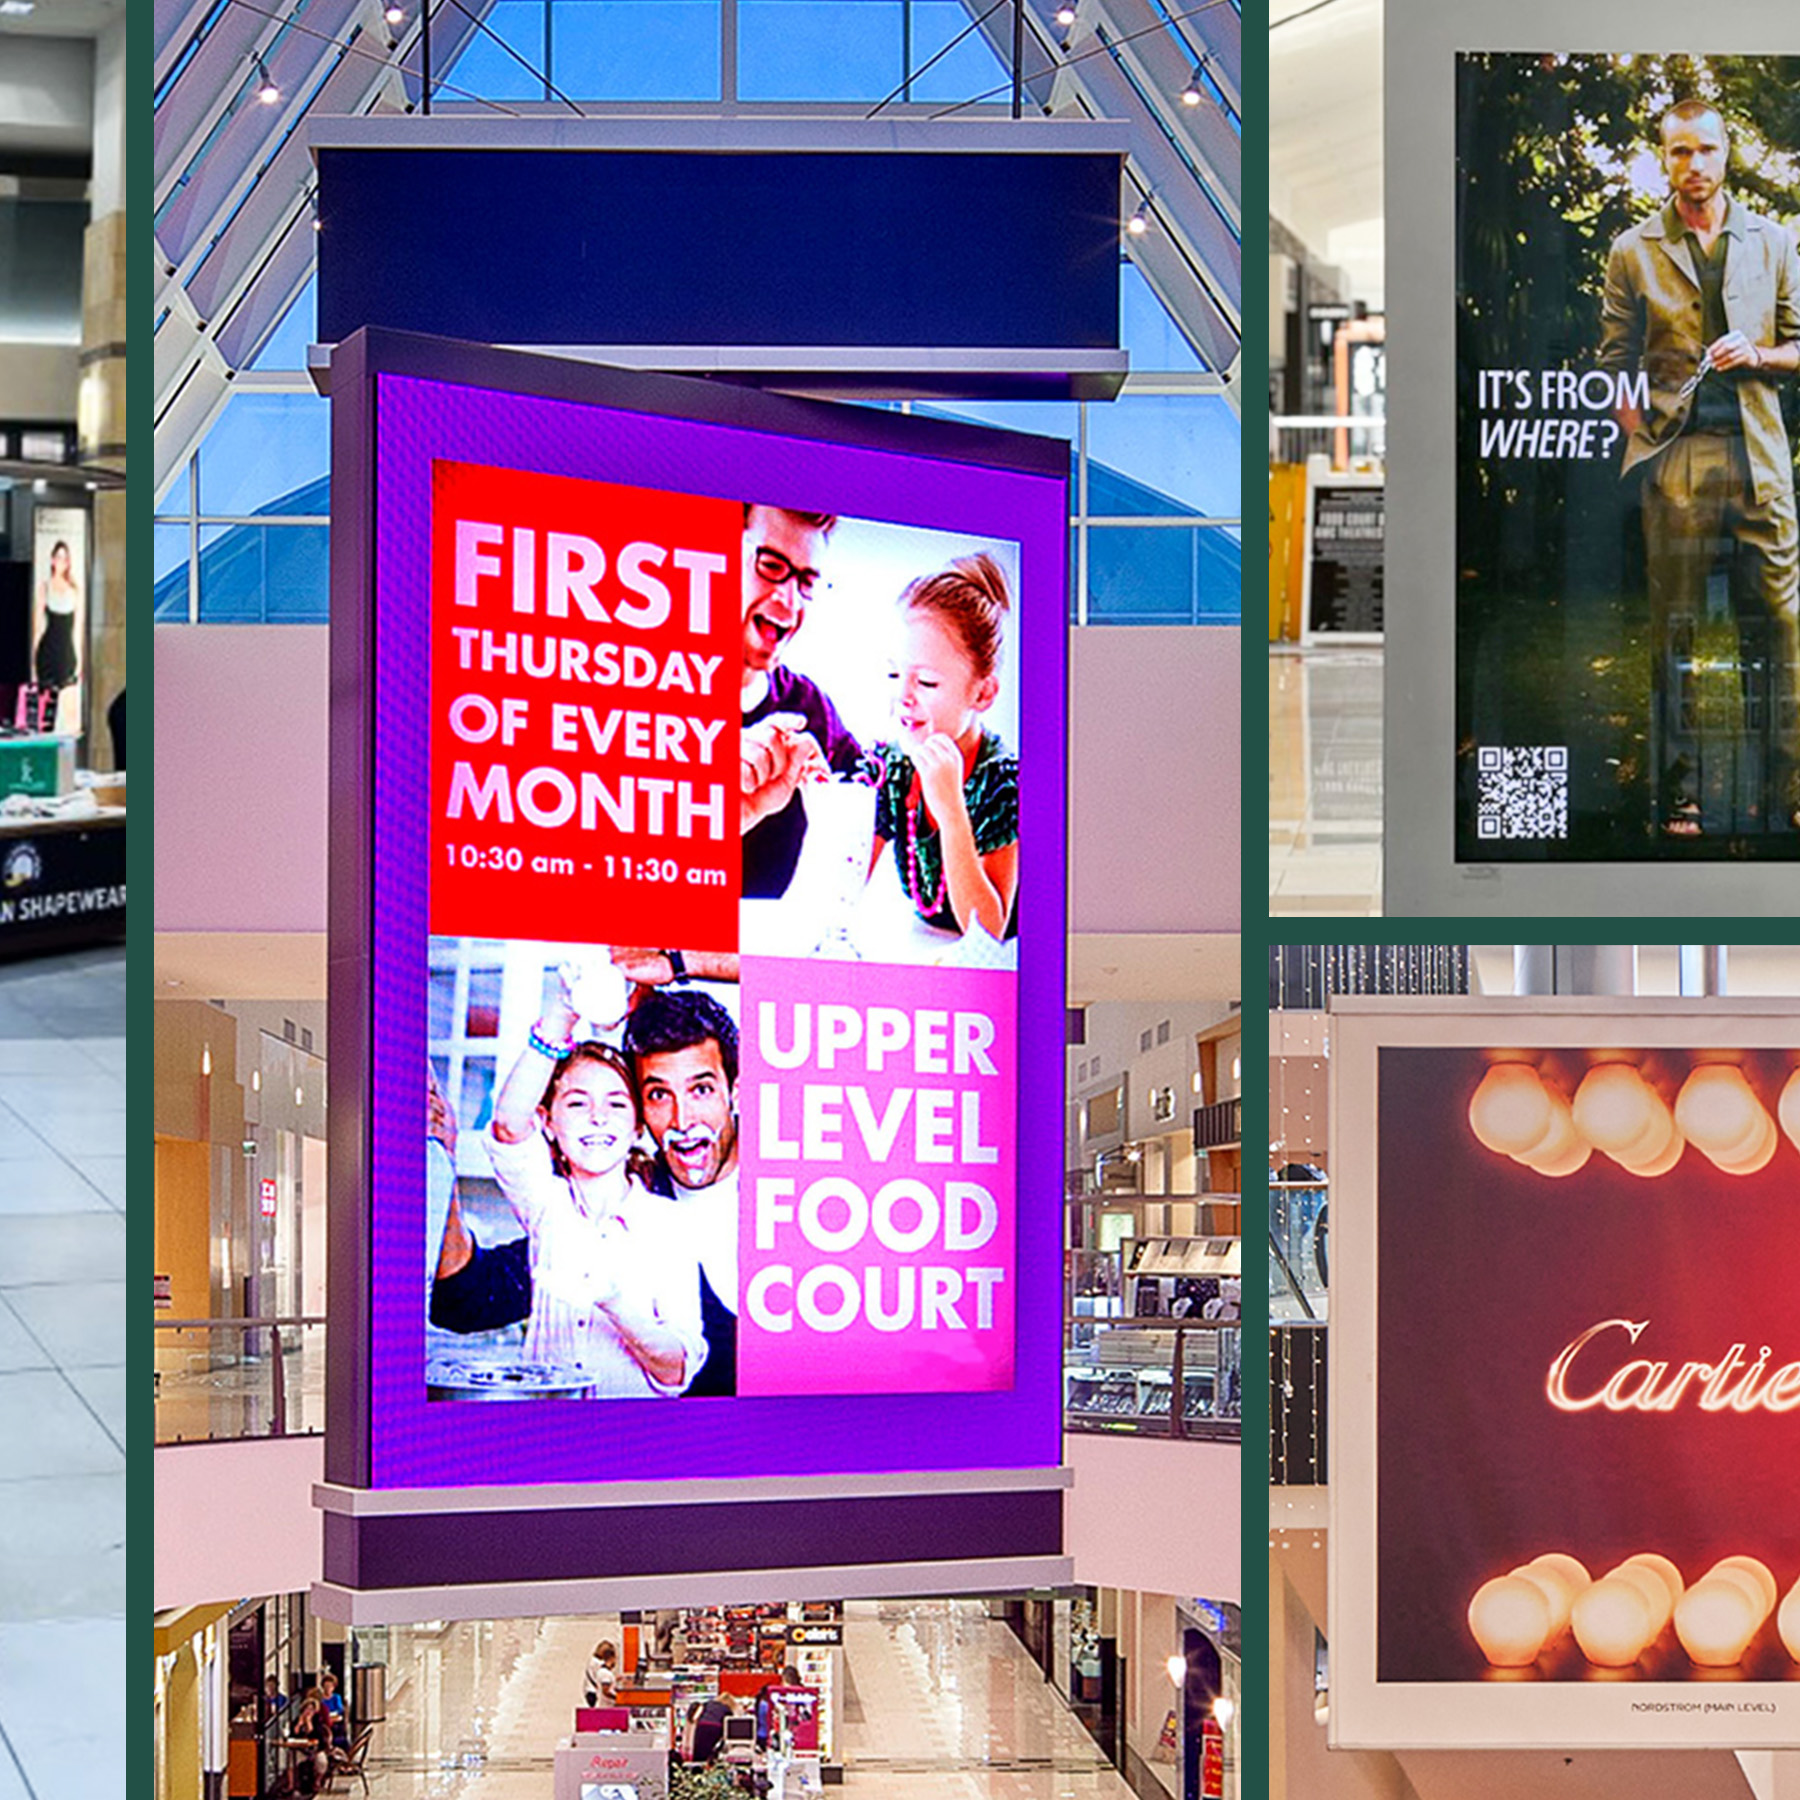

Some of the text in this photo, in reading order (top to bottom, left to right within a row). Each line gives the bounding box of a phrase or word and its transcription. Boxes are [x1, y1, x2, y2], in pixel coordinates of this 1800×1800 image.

[1479, 369, 1651, 411] IT'S FROM
[1479, 419, 1620, 459] WHERE?
[452, 519, 727, 635] FIRST
[451, 626, 723, 695] THURSDAY
[448, 693, 727, 765] OF EVERY
[446, 761, 724, 840] MONTH
[446, 844, 523, 871] 10:30
[531, 856, 574, 875] am
[604, 855, 678, 882] 11:30
[686, 867, 727, 886] am
[758, 1001, 999, 1076] UPPER
[758, 1082, 999, 1164] LEVEL
[755, 1177, 998, 1253] FOOD
[746, 1263, 1005, 1333] COURT
[1631, 1702, 1700, 1713] NORDSTROM
